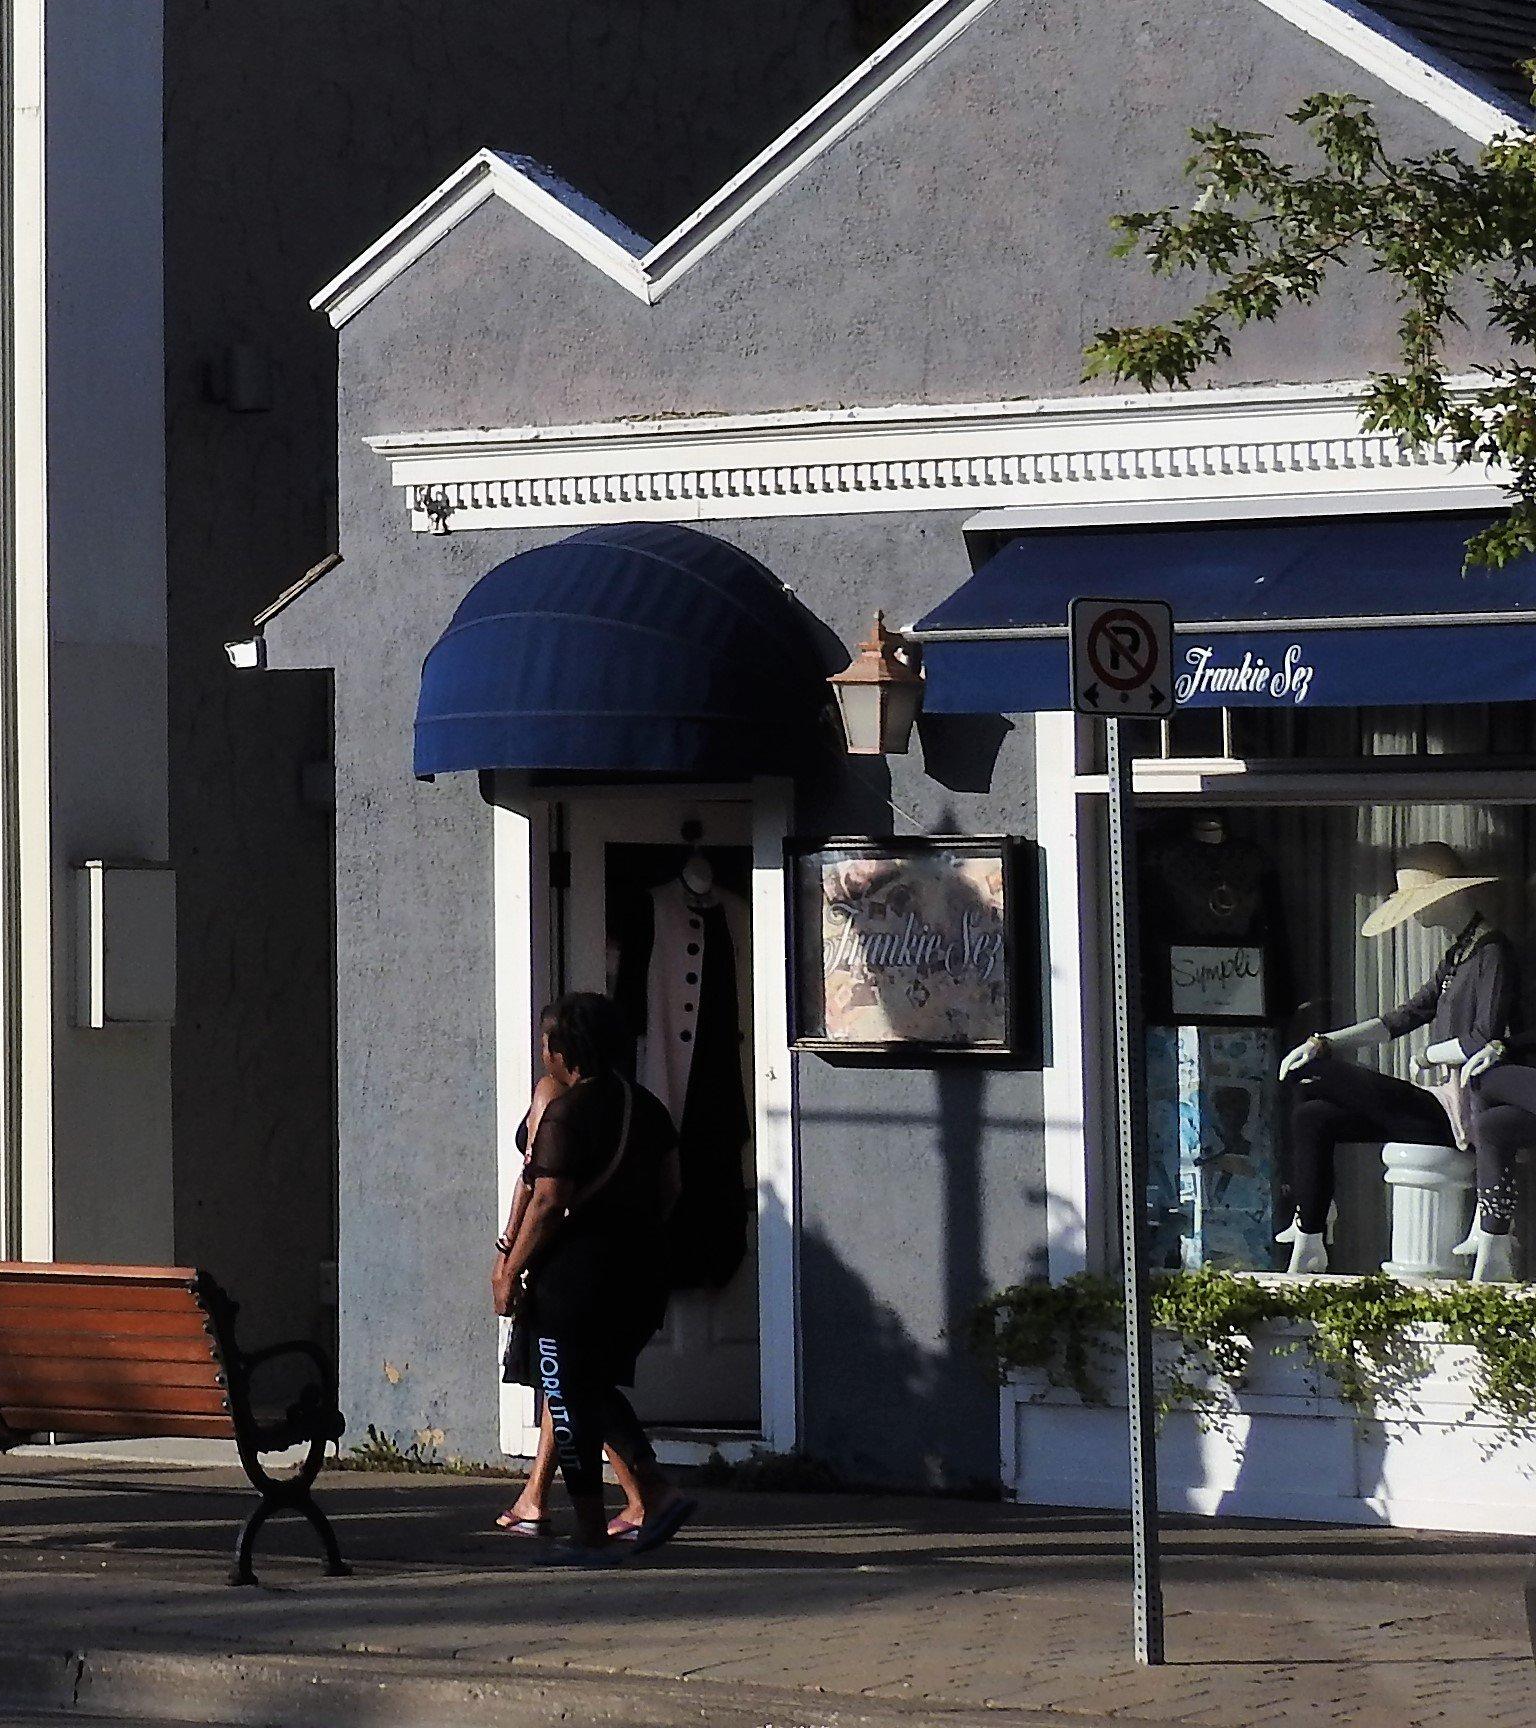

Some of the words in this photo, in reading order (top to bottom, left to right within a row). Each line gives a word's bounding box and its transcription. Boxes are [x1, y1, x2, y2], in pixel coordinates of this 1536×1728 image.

[1175, 646, 1270, 704] Frankie
[1270, 644, 1314, 704] Sez
[825, 901, 944, 975] Frankie
[942, 910, 1005, 984] Sez
[537, 1335, 563, 1400] WORK
[549, 1404, 570, 1423] IT
[554, 1425, 582, 1471] OUT
